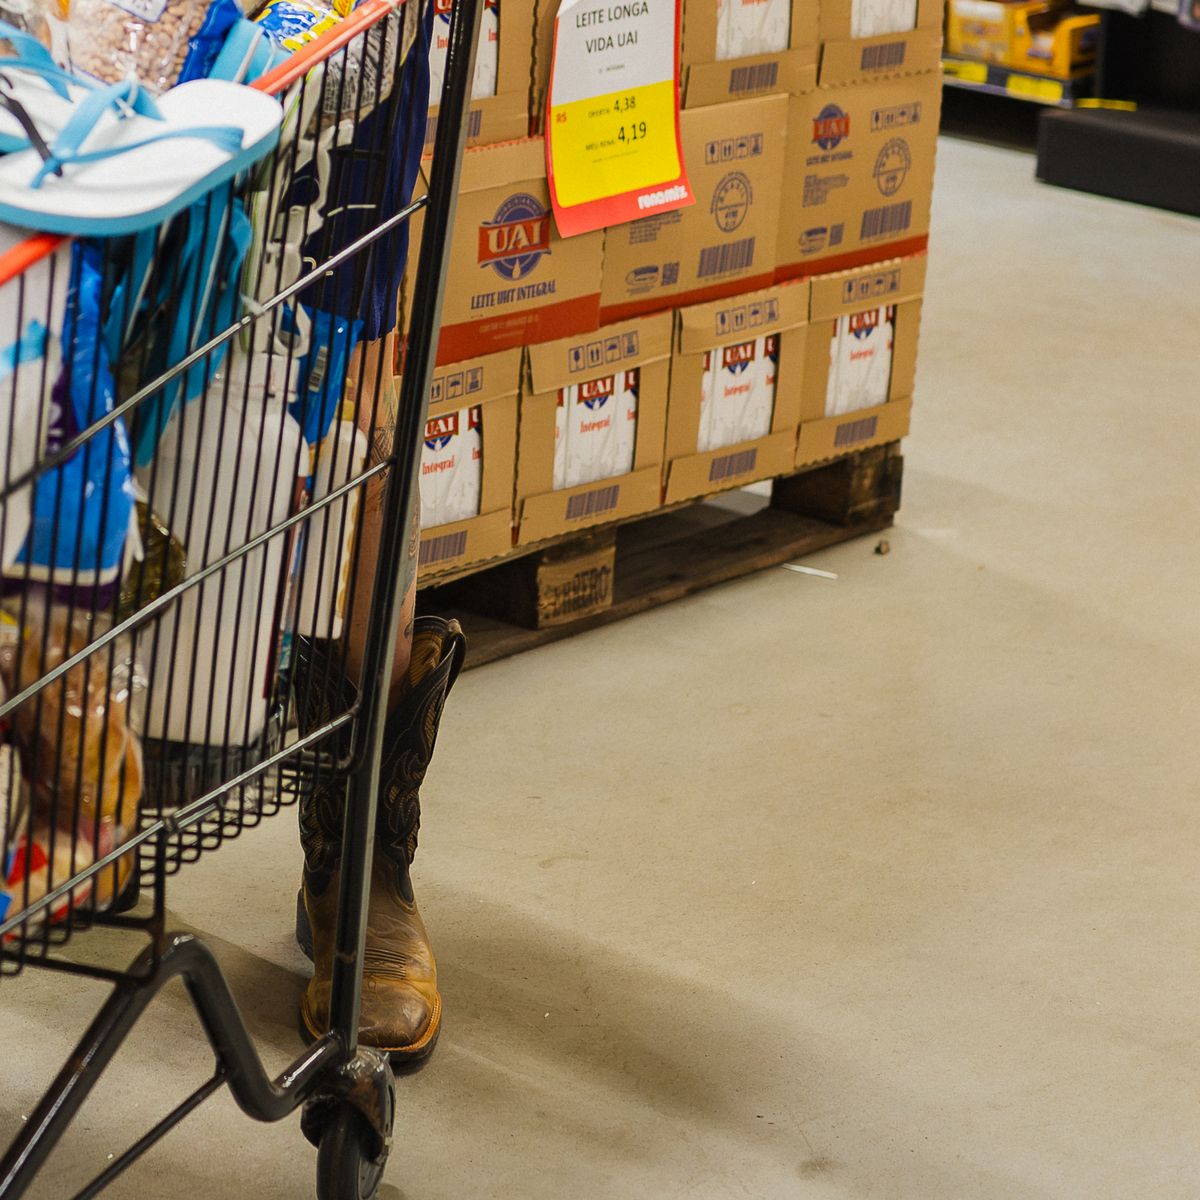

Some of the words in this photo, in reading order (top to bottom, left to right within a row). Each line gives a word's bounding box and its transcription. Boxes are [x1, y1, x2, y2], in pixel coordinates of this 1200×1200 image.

[576, 8, 604, 28] LEITE
[608, 1, 649, 22] LONGA
[585, 35, 613, 54] VIDA
[617, 31, 638, 47] UAI
[614, 96, 636, 114] 4,38
[618, 121, 647, 145] 4,19
[488, 220, 543, 254] UAI
[471, 292, 496, 310] LEITE
[497, 288, 515, 305] UHT
[516, 280, 556, 300] INTEGRAL
[726, 344, 753, 364] UAI
[582, 377, 612, 398] UAI
[426, 414, 454, 437] UAI
[580, 415, 611, 433] Integral
[422, 455, 456, 475] Integral
